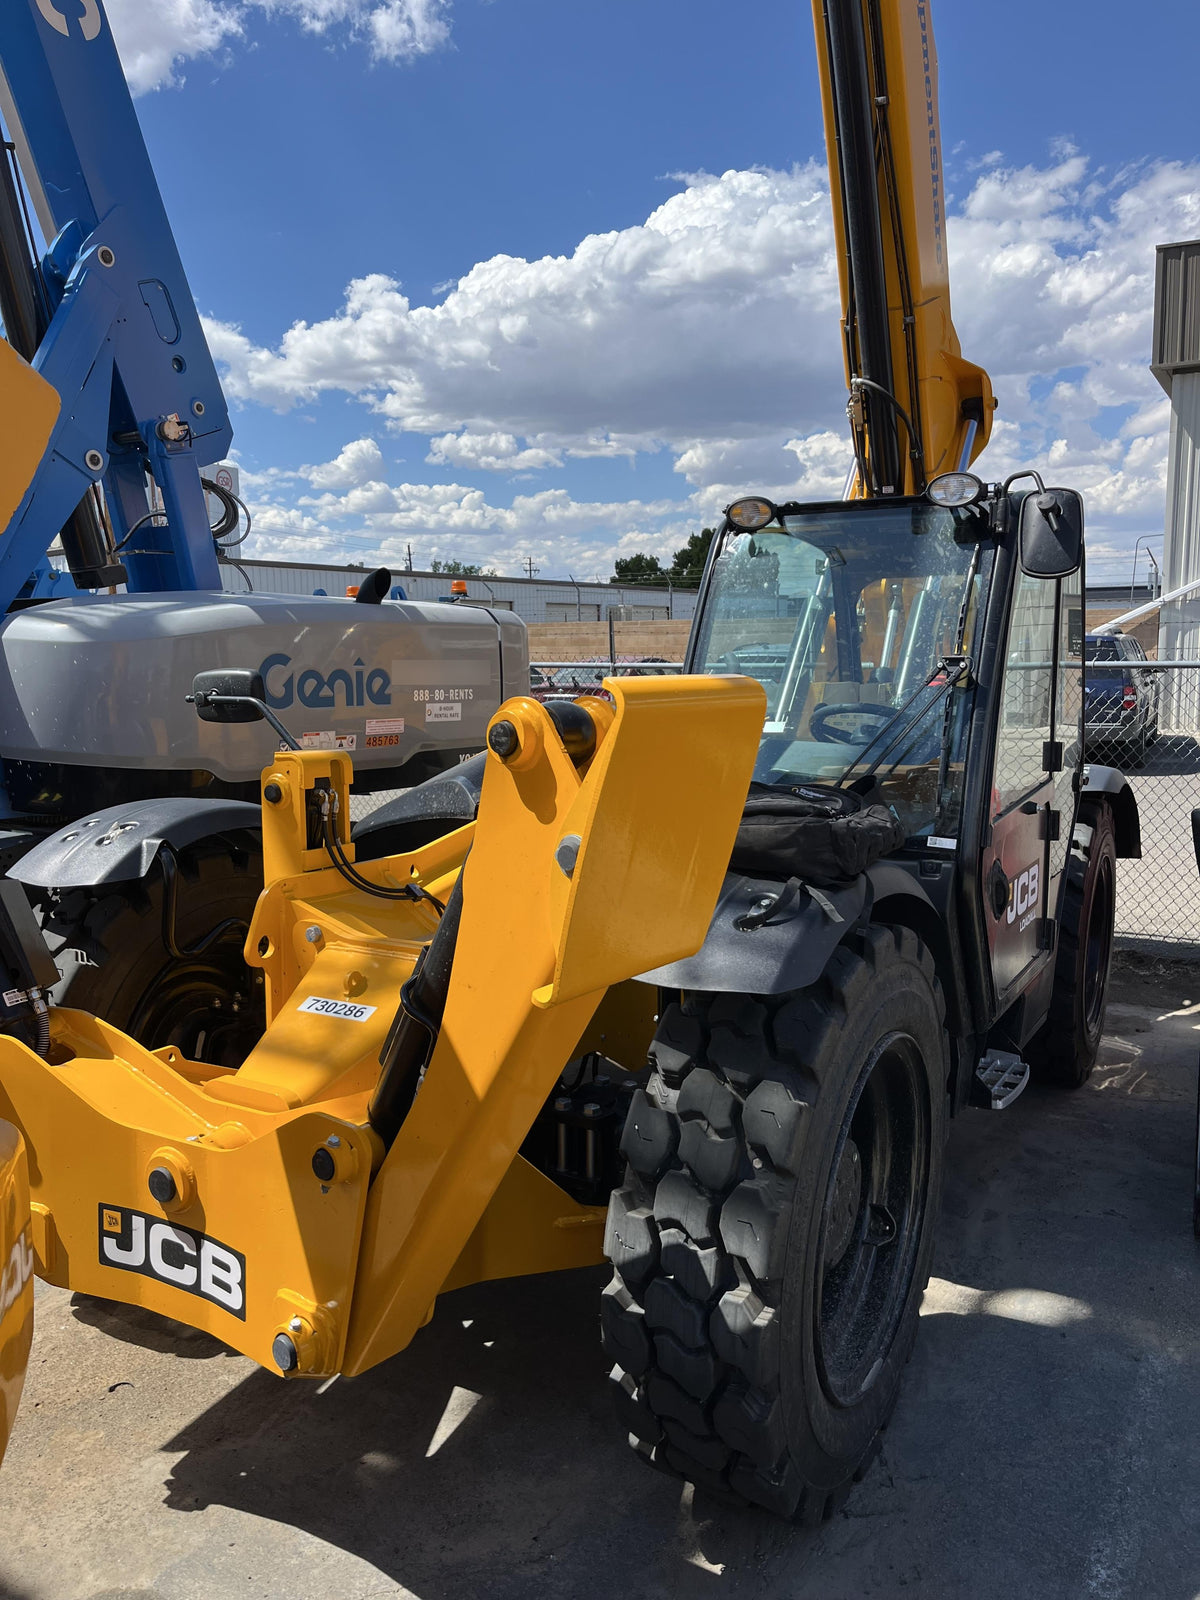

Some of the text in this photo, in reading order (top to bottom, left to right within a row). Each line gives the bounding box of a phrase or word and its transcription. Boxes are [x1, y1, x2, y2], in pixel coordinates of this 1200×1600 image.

[258, 653, 391, 709] Genie
[413, 689, 474, 701] 888-80-RENTS
[366, 735, 400, 747] 485763
[1006, 864, 1039, 924] JCB
[306, 998, 367, 1018] 730286
[103, 1215, 243, 1310] JCB
